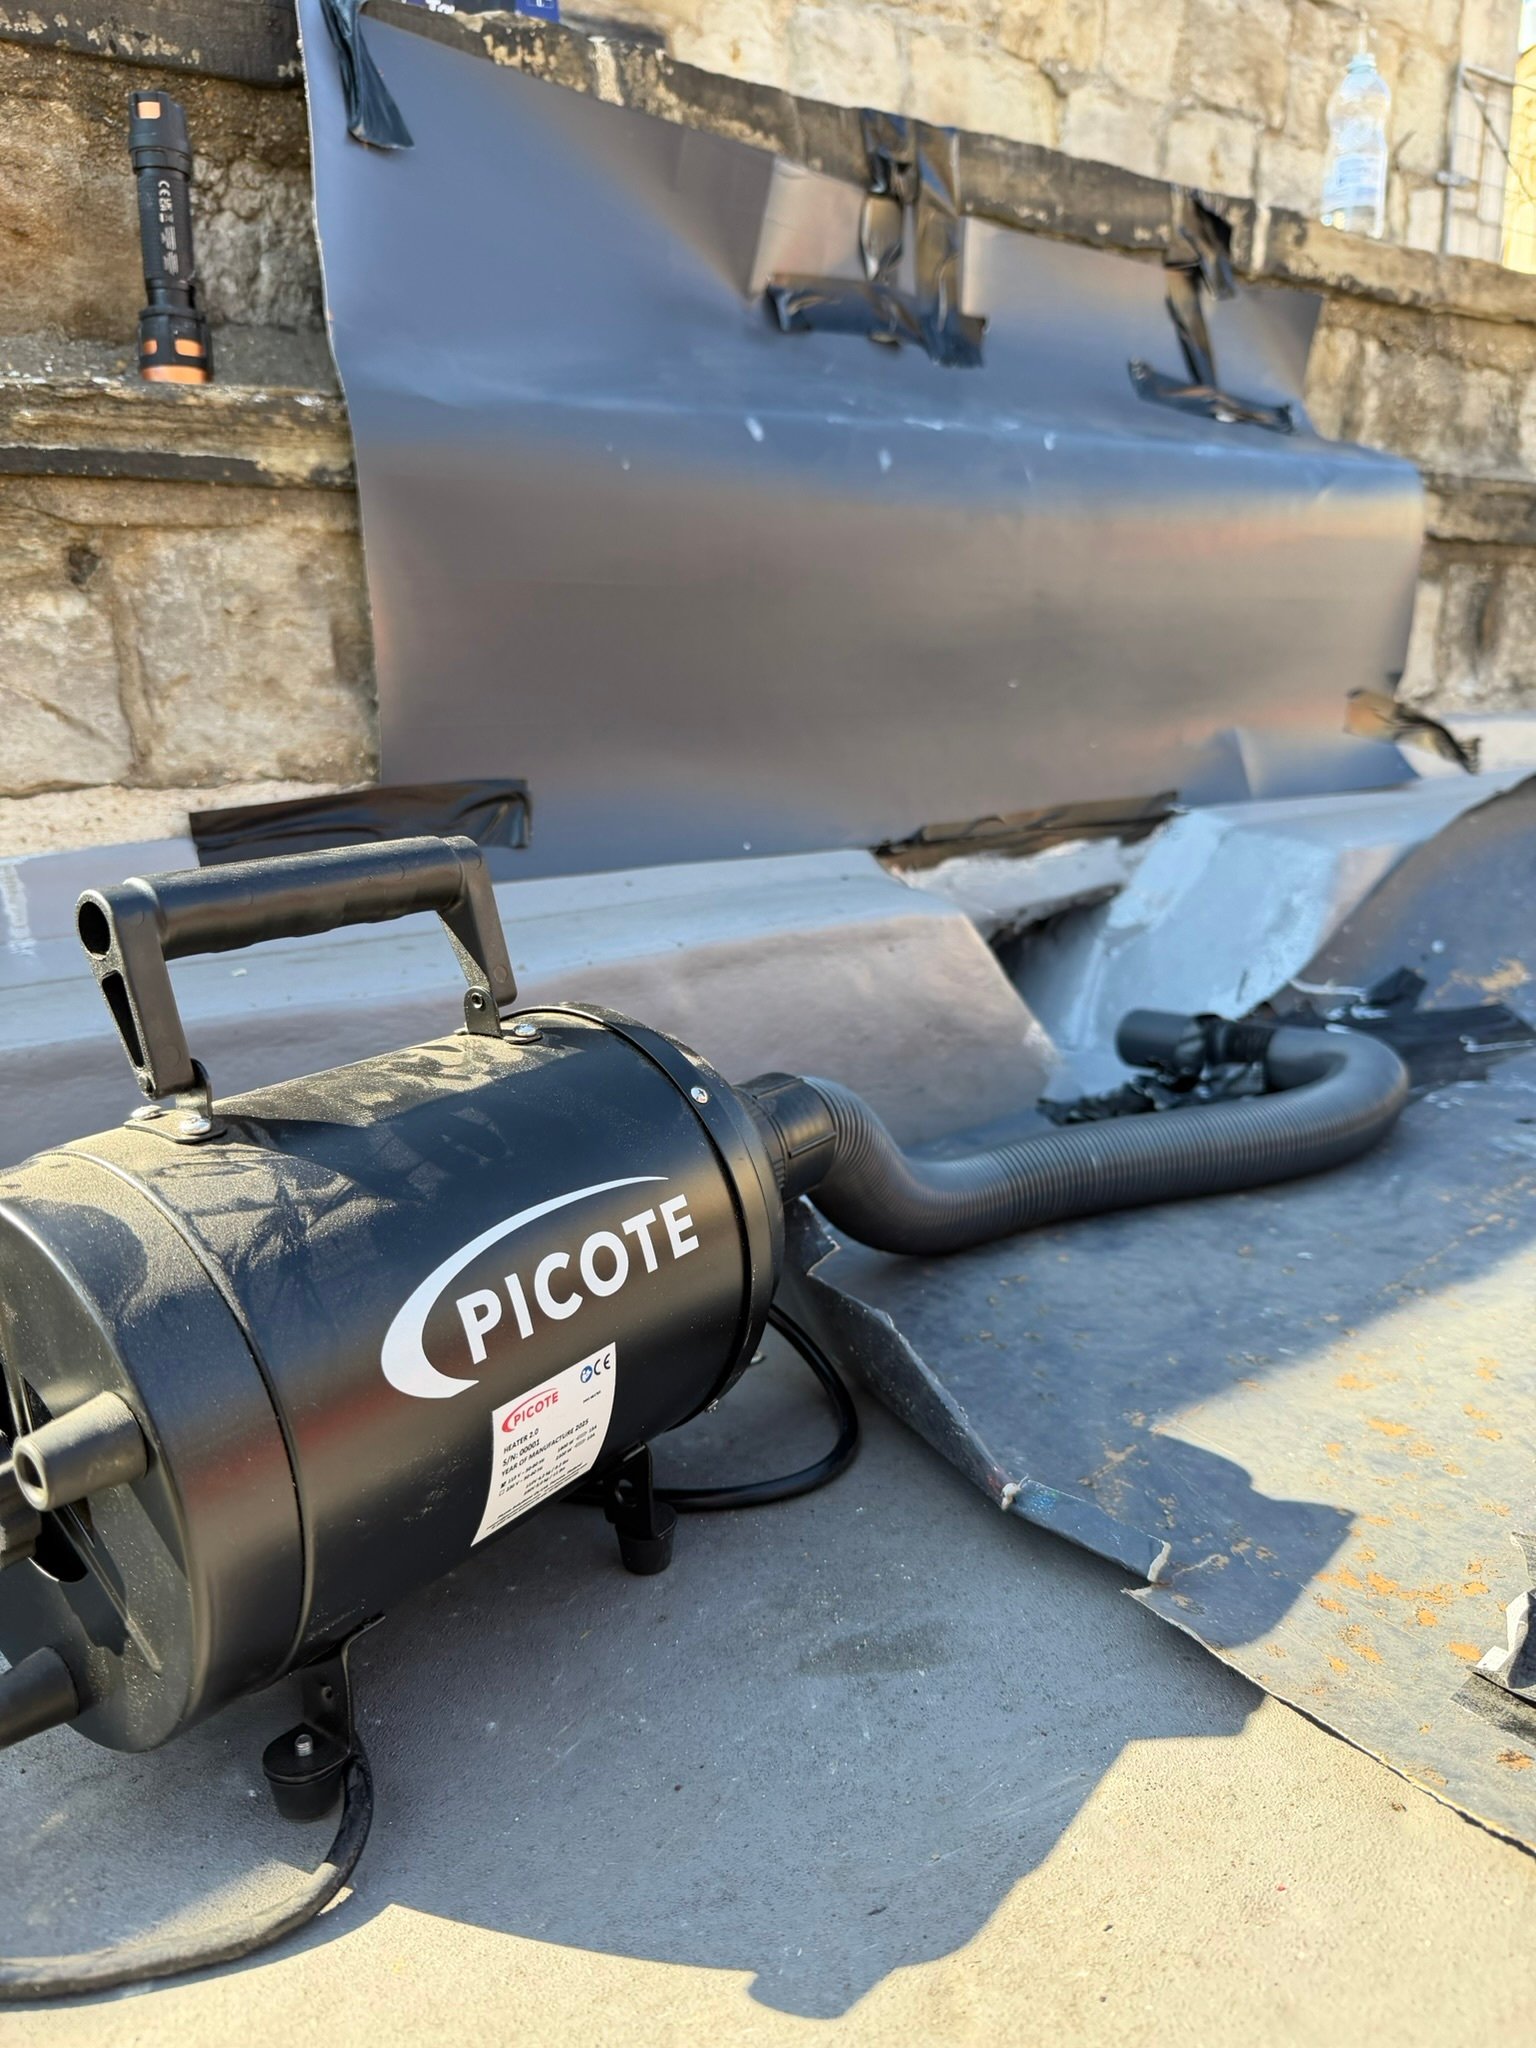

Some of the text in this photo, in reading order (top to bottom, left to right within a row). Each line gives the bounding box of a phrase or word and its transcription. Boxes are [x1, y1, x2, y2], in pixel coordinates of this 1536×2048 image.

[456, 1193, 700, 1365] PICOTE
[593, 1353, 611, 1376] CE
[513, 1391, 559, 1427] PICOTE
[501, 1462, 518, 1477] YEAR
[518, 1456, 527, 1466] OF
[528, 1427, 574, 1459] MANUFACTURE
[502, 1452, 518, 1467] S/N:
[519, 1438, 540, 1456] 00001
[503, 1427, 539, 1454] HEATER 2.0
